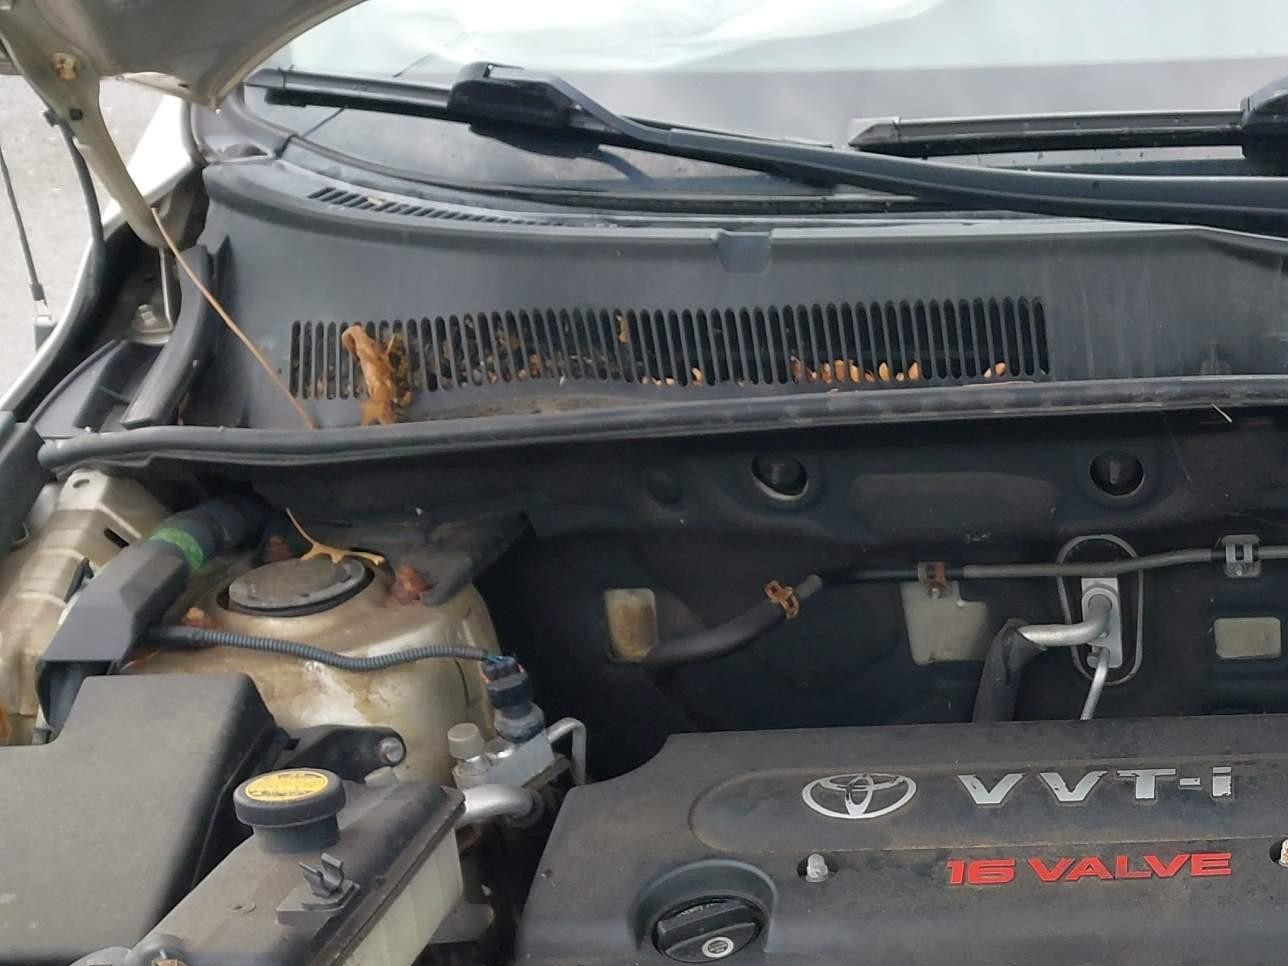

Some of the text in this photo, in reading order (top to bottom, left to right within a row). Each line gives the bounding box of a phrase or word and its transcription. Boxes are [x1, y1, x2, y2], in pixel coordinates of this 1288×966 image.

[957, 767, 1232, 804] VVT-i
[947, 853, 1232, 885] 16 VALVE
